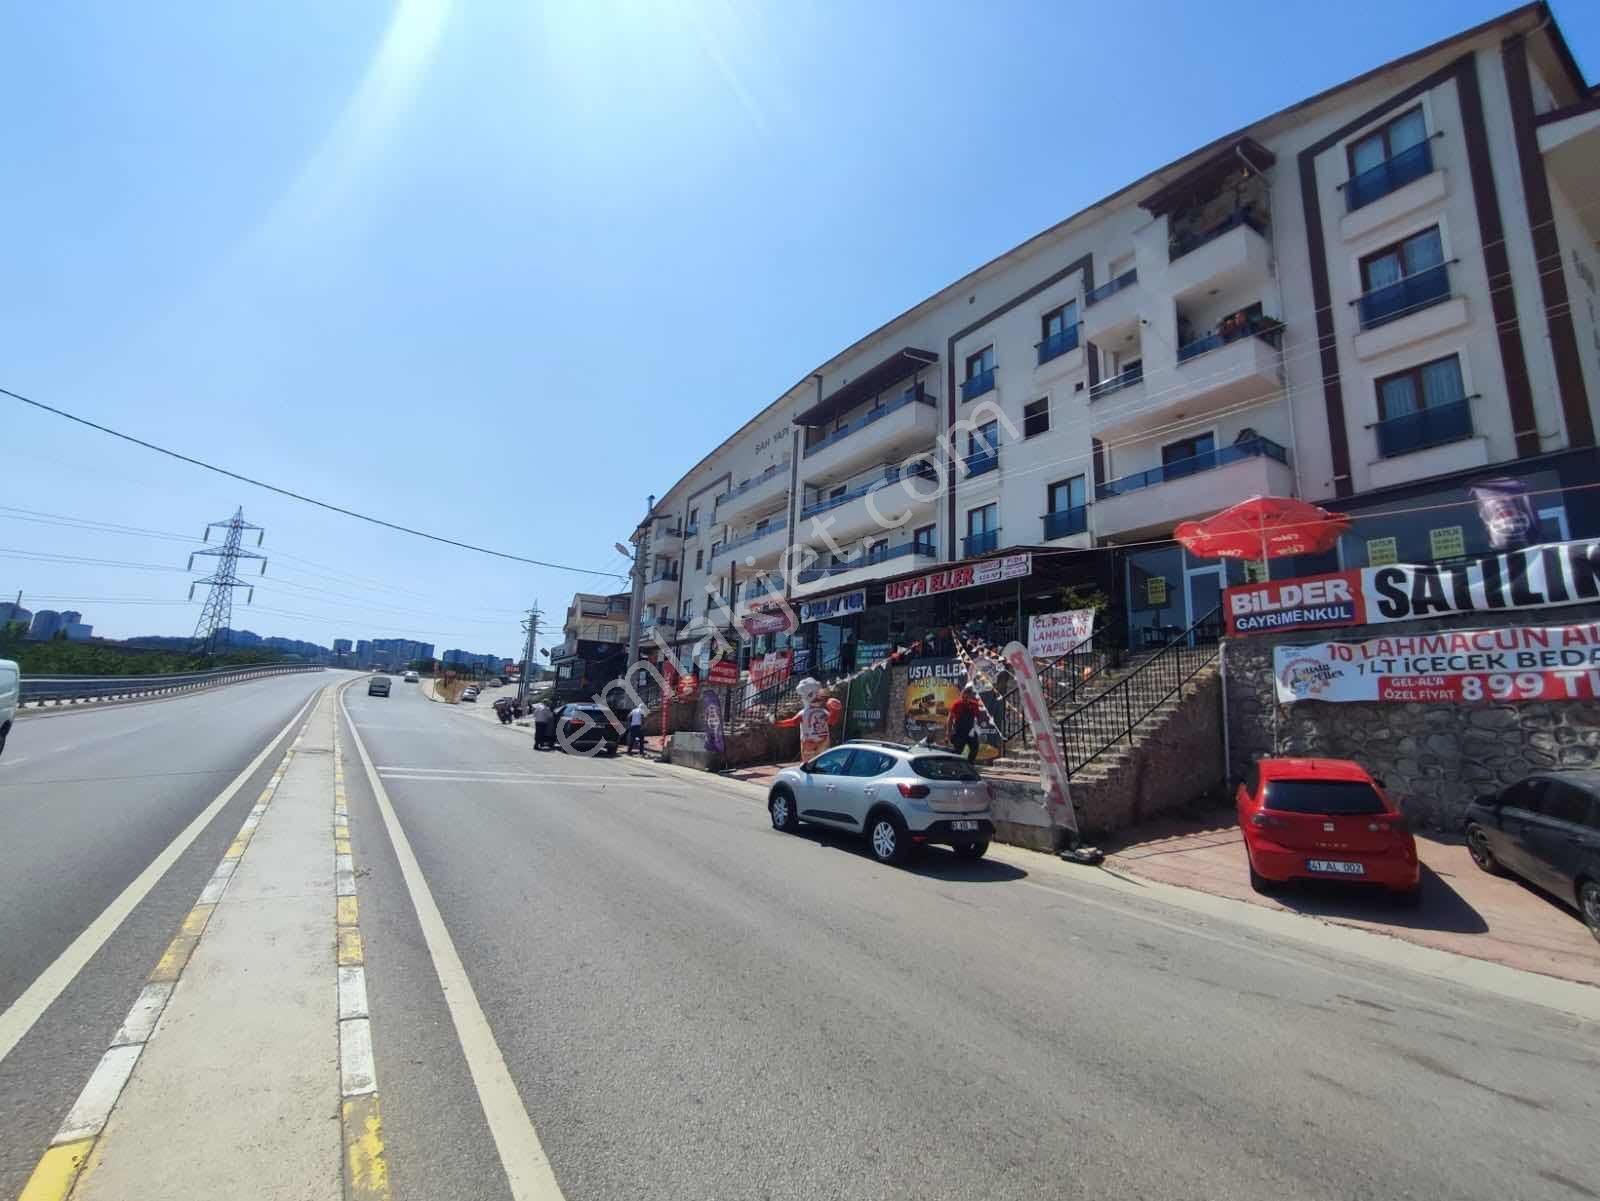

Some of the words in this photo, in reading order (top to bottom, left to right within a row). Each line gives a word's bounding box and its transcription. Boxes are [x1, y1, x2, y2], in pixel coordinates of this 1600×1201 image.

[888, 578, 927, 601] USTA
[929, 565, 975, 592] ELLER
[1327, 643, 1353, 662] 10
[1361, 627, 1549, 660] LAHMACUN
[909, 664, 933, 679] USTA
[1370, 658, 1397, 673] LT
[1383, 687, 1417, 700] ÖZEL
[1461, 671, 1544, 700] 899
